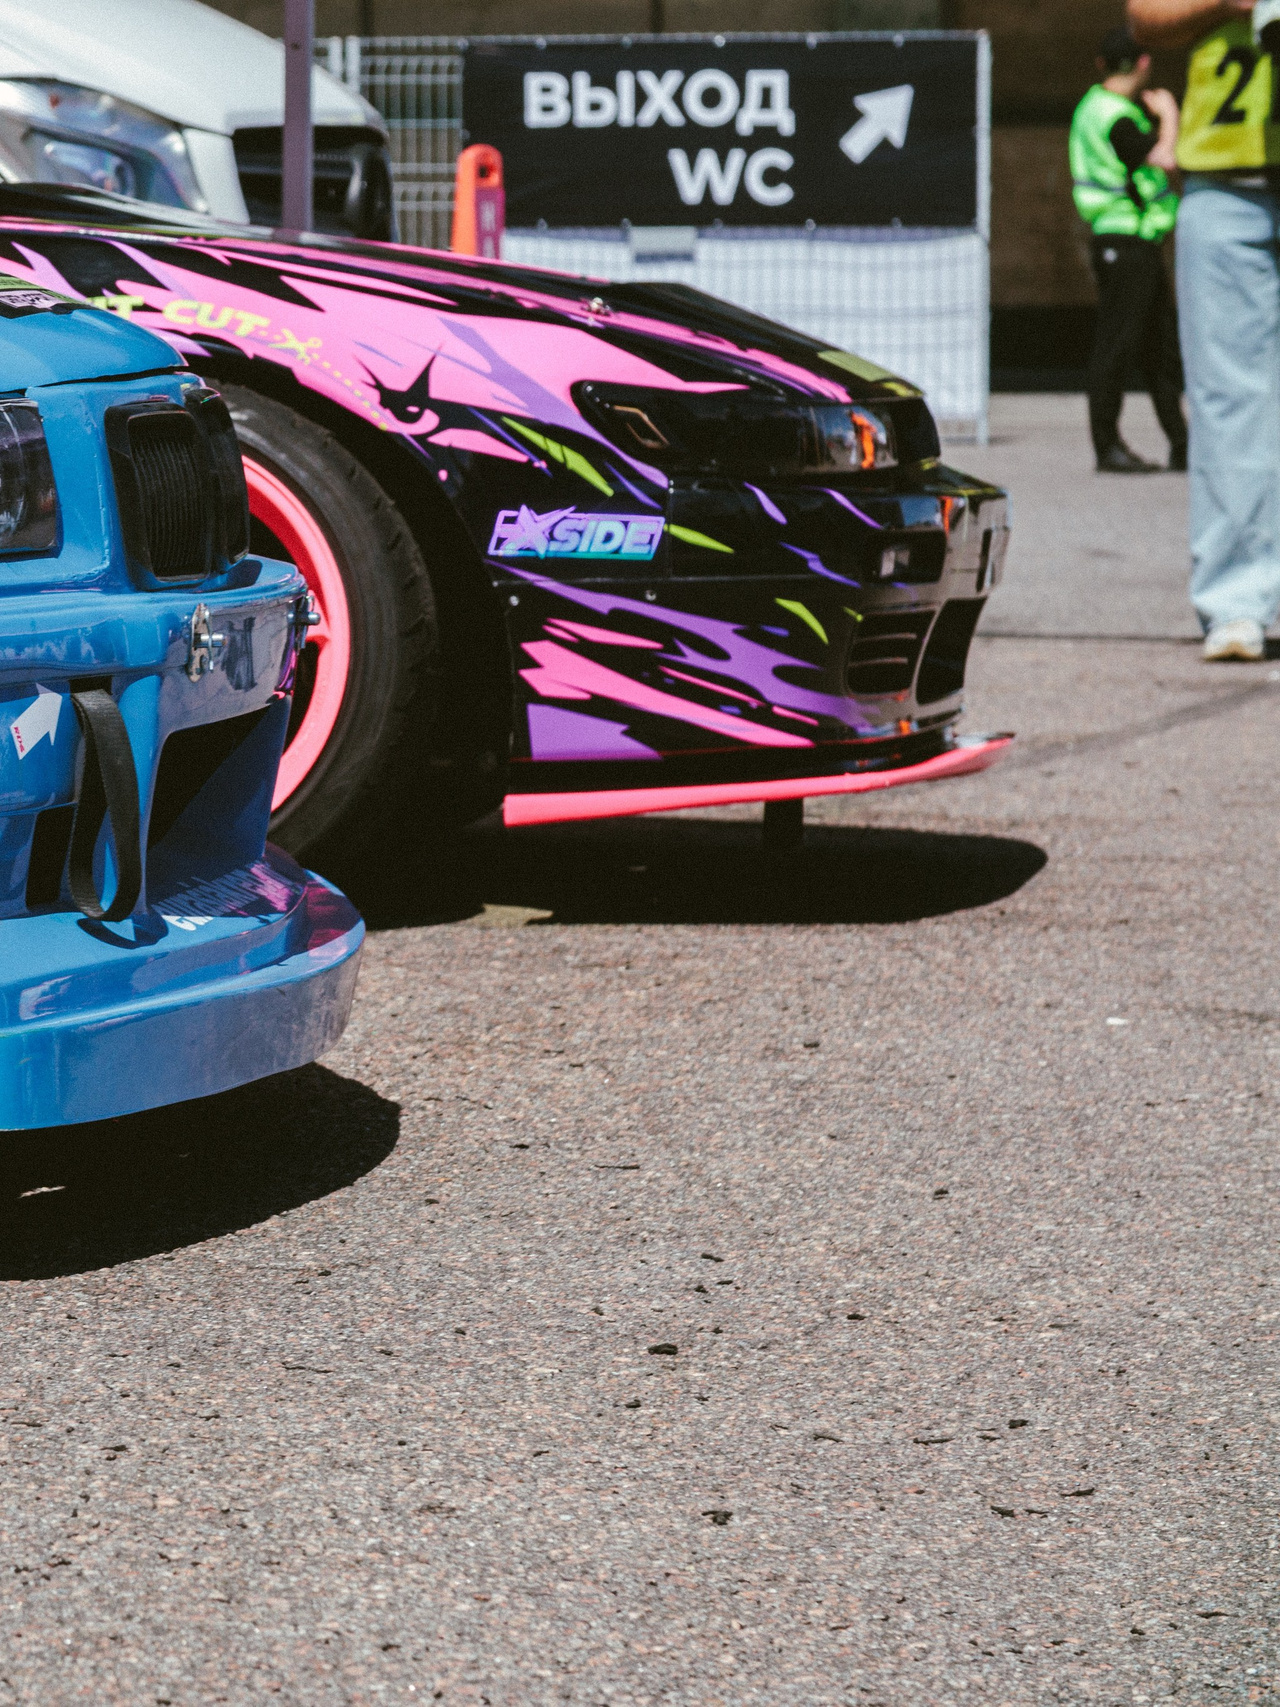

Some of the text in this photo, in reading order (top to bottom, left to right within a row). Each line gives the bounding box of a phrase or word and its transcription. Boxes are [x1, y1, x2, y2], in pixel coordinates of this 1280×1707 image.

[523, 68, 796, 137] ВЫХОД
[667, 147, 795, 207] WC
[162, 299, 270, 337] CUT
